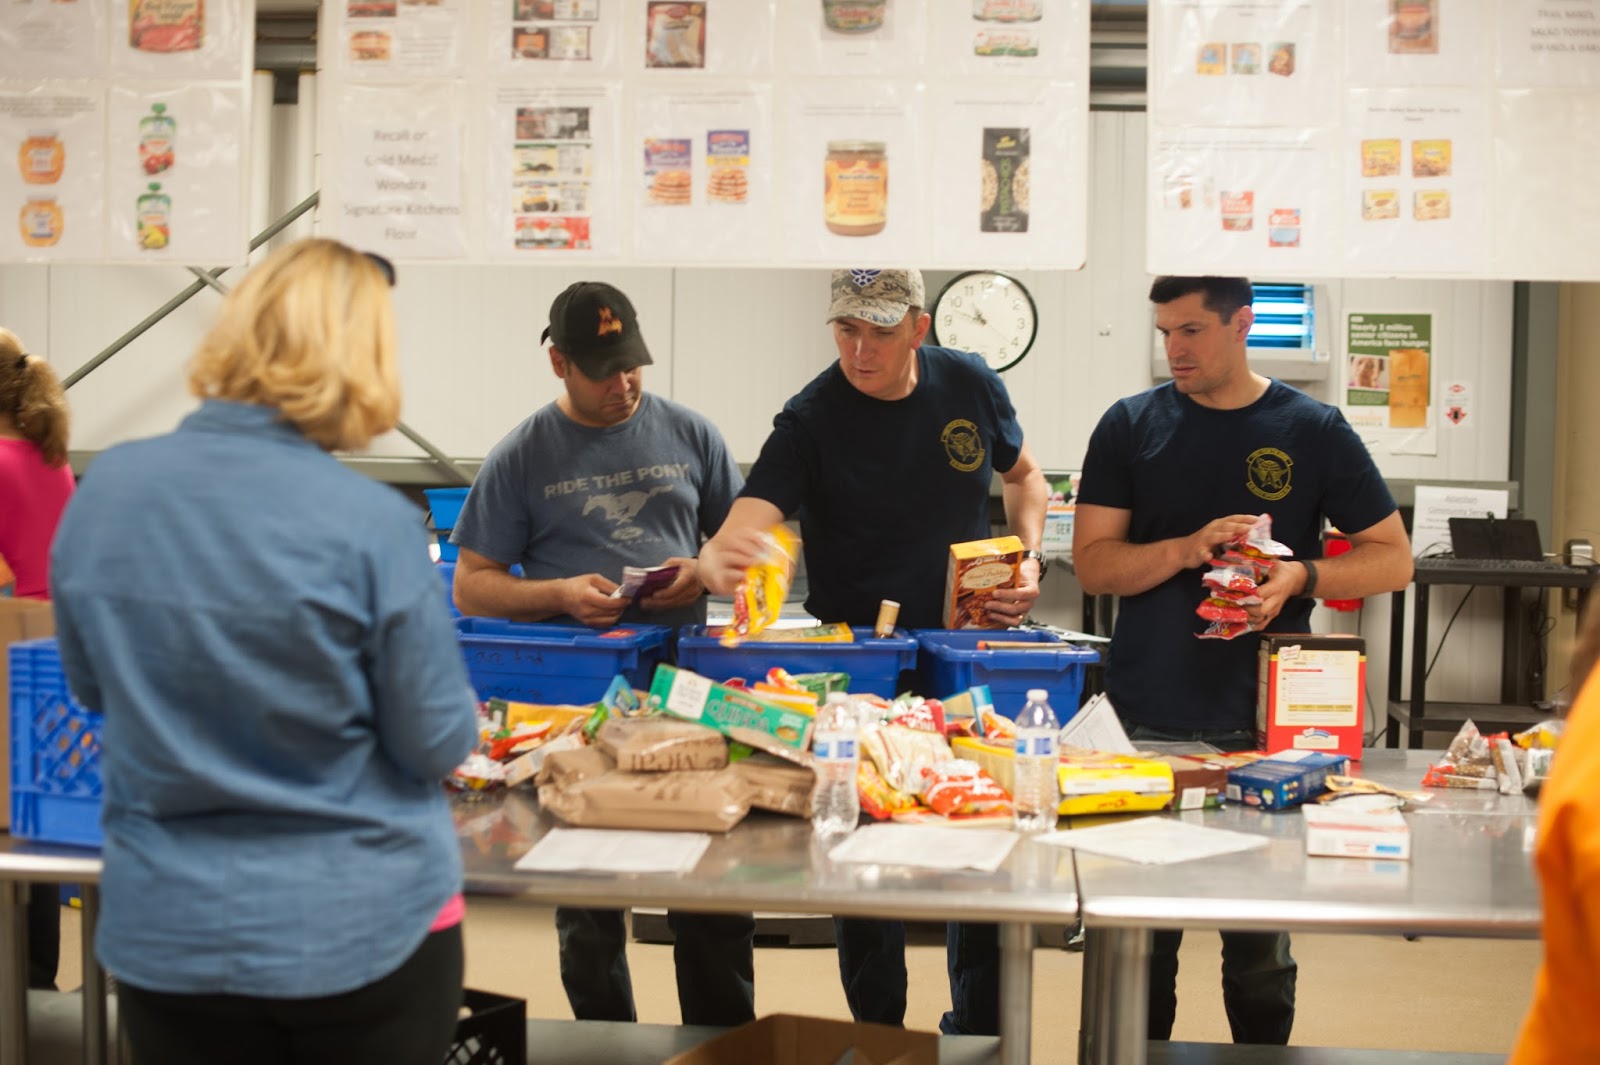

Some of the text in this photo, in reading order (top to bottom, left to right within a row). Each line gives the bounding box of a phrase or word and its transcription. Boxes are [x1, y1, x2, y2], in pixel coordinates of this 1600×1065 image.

[365, 154, 395, 166] Gld
[964, 286, 974, 296] 11
[944, 314, 953, 326] 9
[1017, 317, 1026, 330] 3
[949, 334, 958, 346] 8
[1011, 337, 1019, 346] 4
[1350, 339, 1382, 347] America
[999, 347, 1007, 360] 5
[544, 463, 690, 497] RIDE THE PONY
